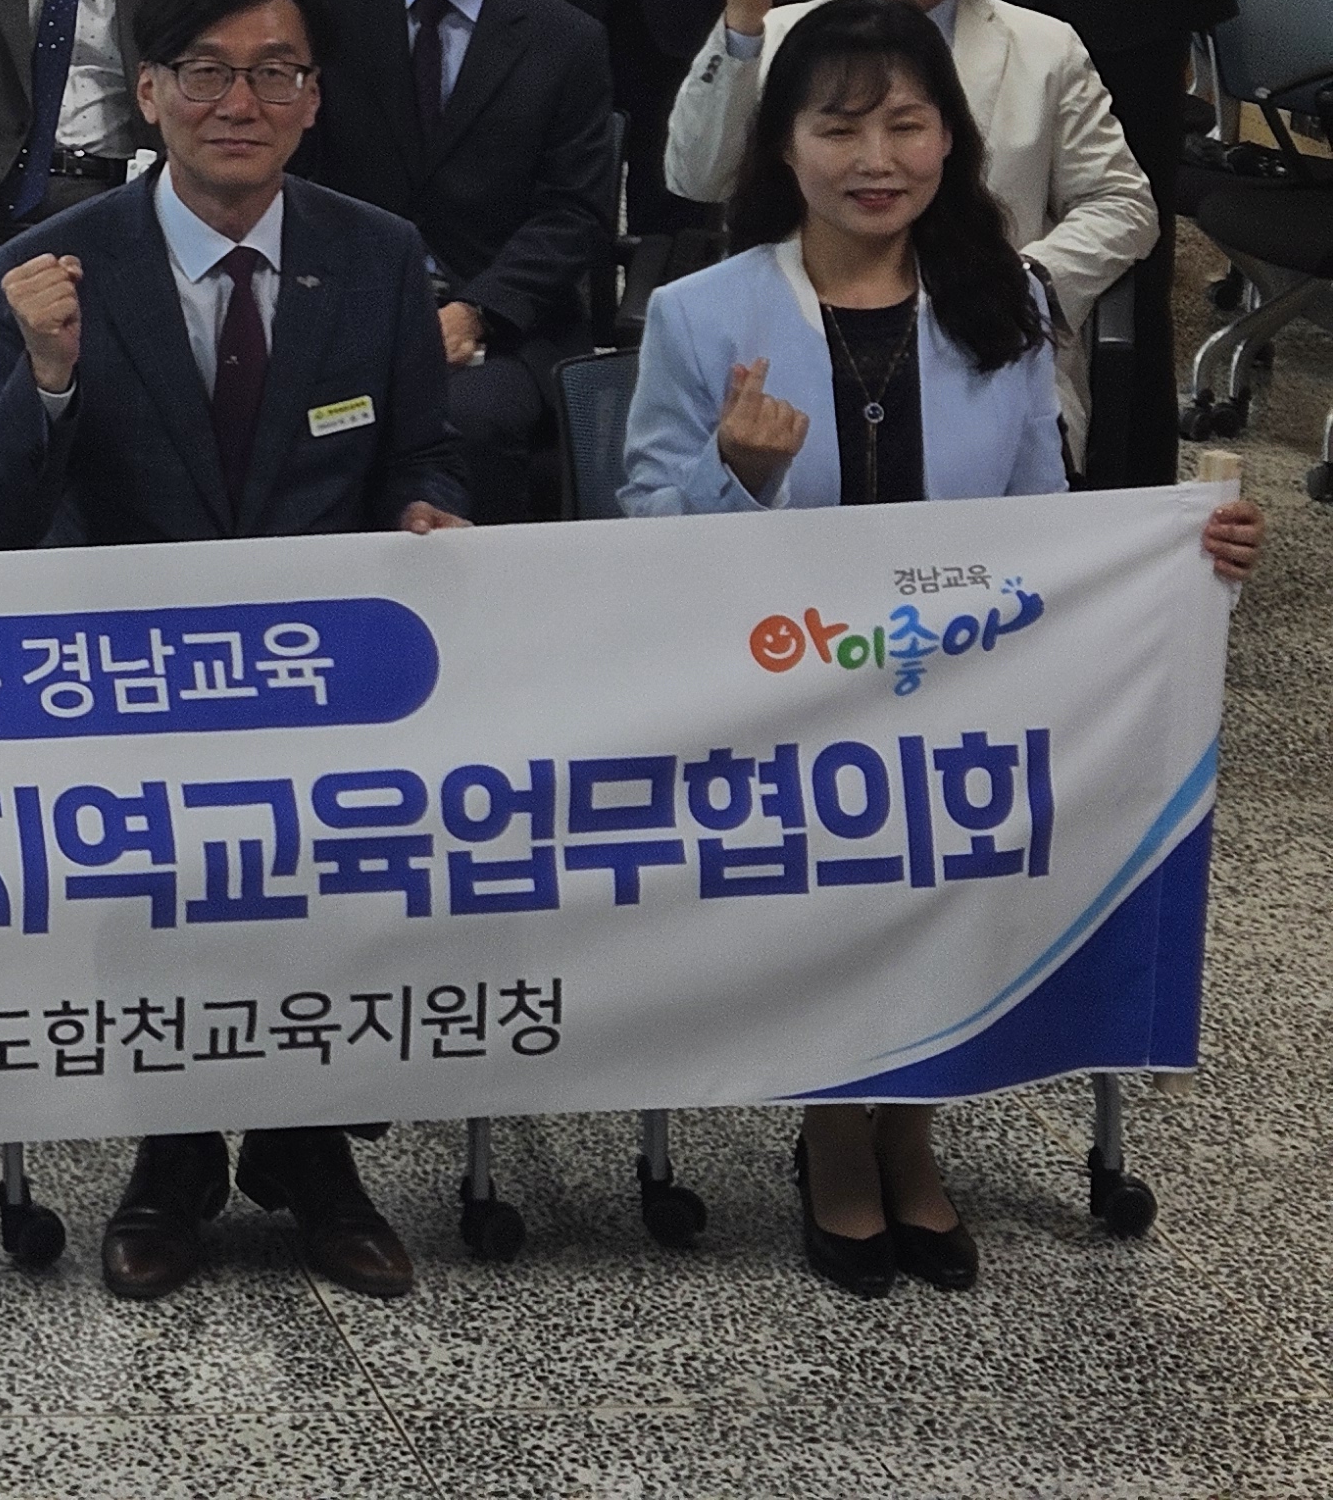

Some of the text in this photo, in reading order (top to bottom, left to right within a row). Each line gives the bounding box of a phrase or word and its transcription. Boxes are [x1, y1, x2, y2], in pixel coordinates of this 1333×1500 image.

[893, 564, 992, 596] 경남교육
[21, 618, 335, 719] 경남교육
[749, 589, 1045, 697] 아이좋아
